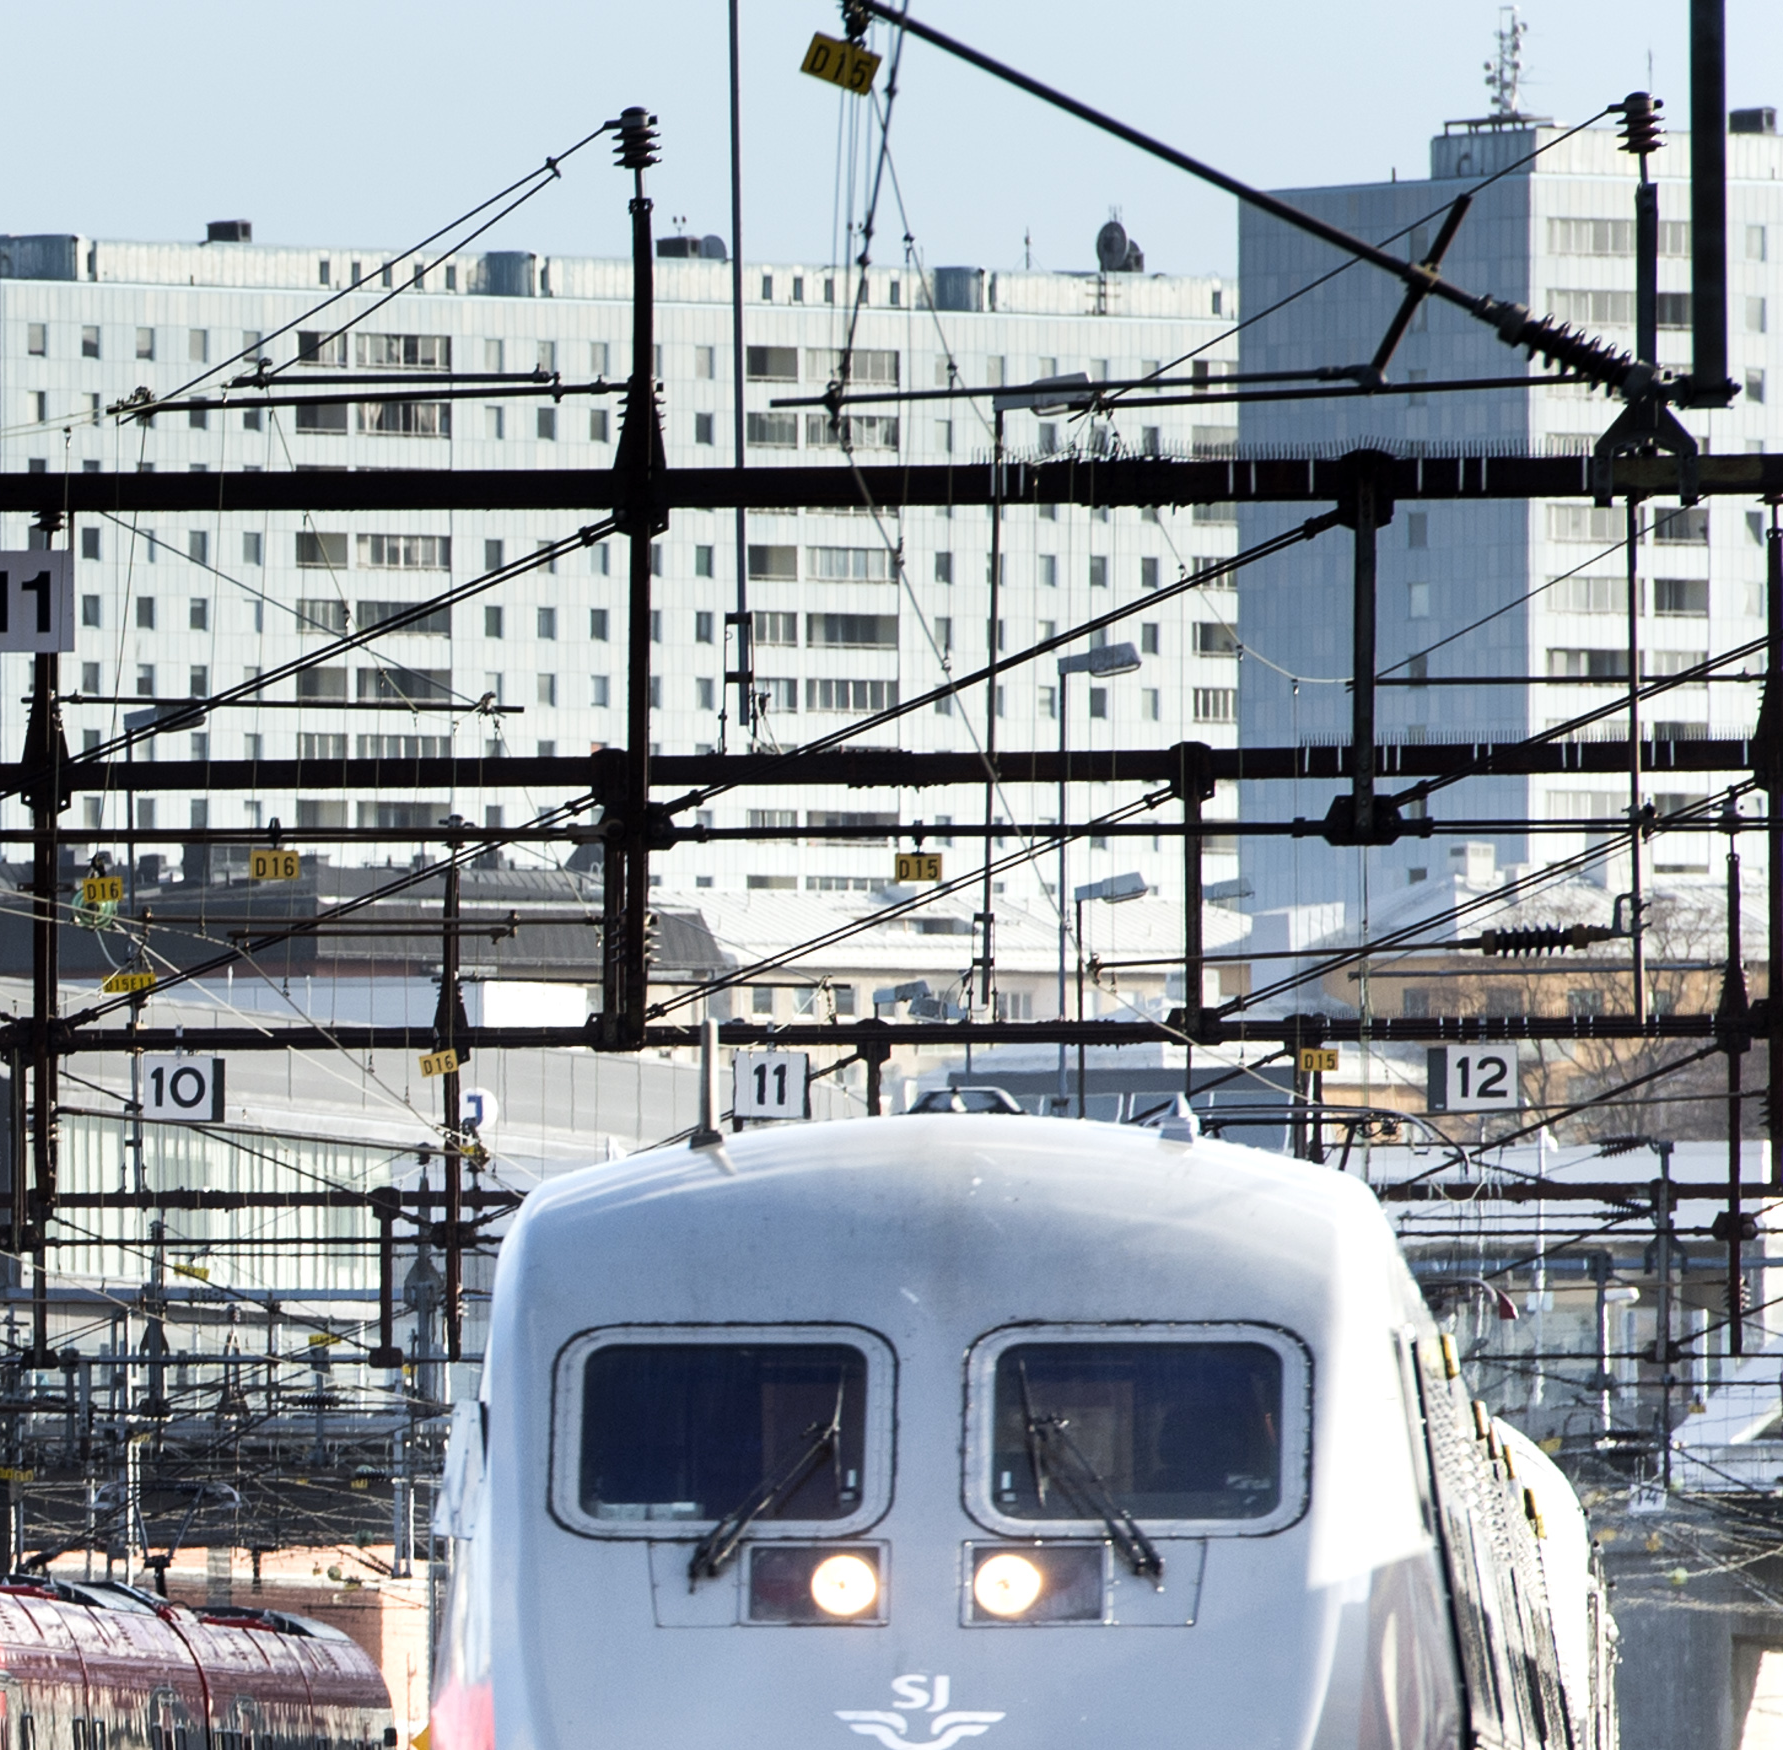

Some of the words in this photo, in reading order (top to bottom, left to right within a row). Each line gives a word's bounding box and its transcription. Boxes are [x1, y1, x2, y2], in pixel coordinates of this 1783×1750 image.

[808, 43, 871, 89] D15
[255, 857, 294, 878] D16
[899, 858, 938, 879] D15
[87, 881, 119, 900] D16
[424, 1054, 454, 1075] D16
[1305, 1053, 1336, 1070] D15
[150, 1066, 206, 1109] 10
[754, 1063, 787, 1105] 11
[1456, 1056, 1508, 1099] 12
[891, 1673, 951, 1713] SJ
